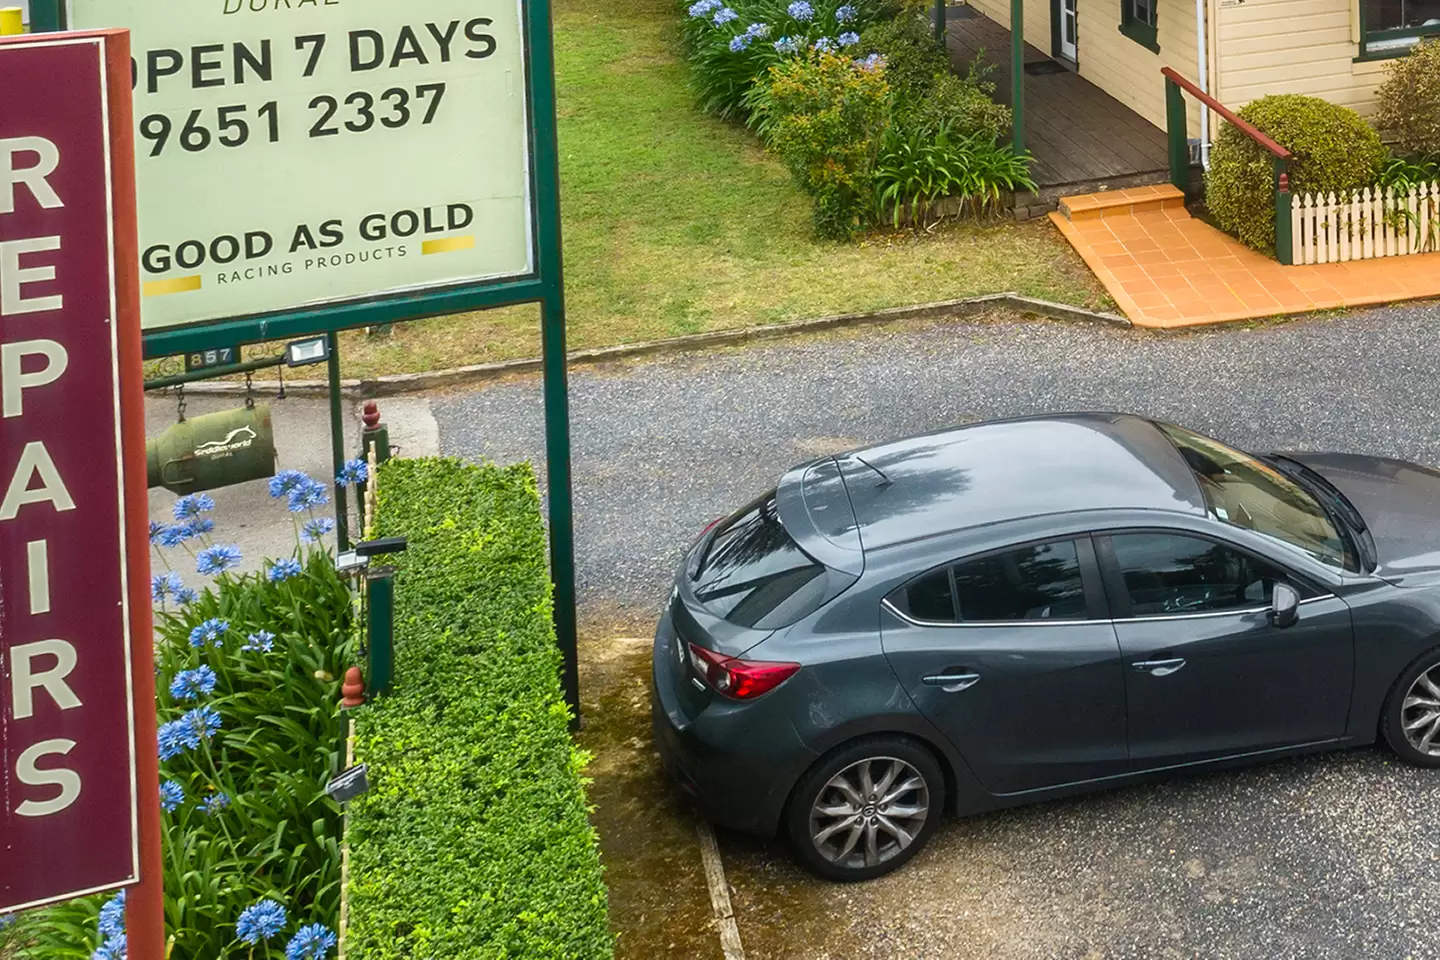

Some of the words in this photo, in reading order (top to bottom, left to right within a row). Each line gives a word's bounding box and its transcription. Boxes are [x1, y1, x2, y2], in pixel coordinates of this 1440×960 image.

[130, 39, 273, 94] PEN
[294, 34, 327, 78] 7
[349, 17, 497, 72] DAYS
[139, 101, 281, 158] 9651
[308, 82, 446, 139] 2337
[141, 232, 273, 274] GOOD
[288, 219, 344, 253] AS
[359, 202, 475, 241] GOLD
[217, 262, 293, 285] RACING
[304, 245, 408, 270] PRODUCTS
[191, 348, 231, 366] 857
